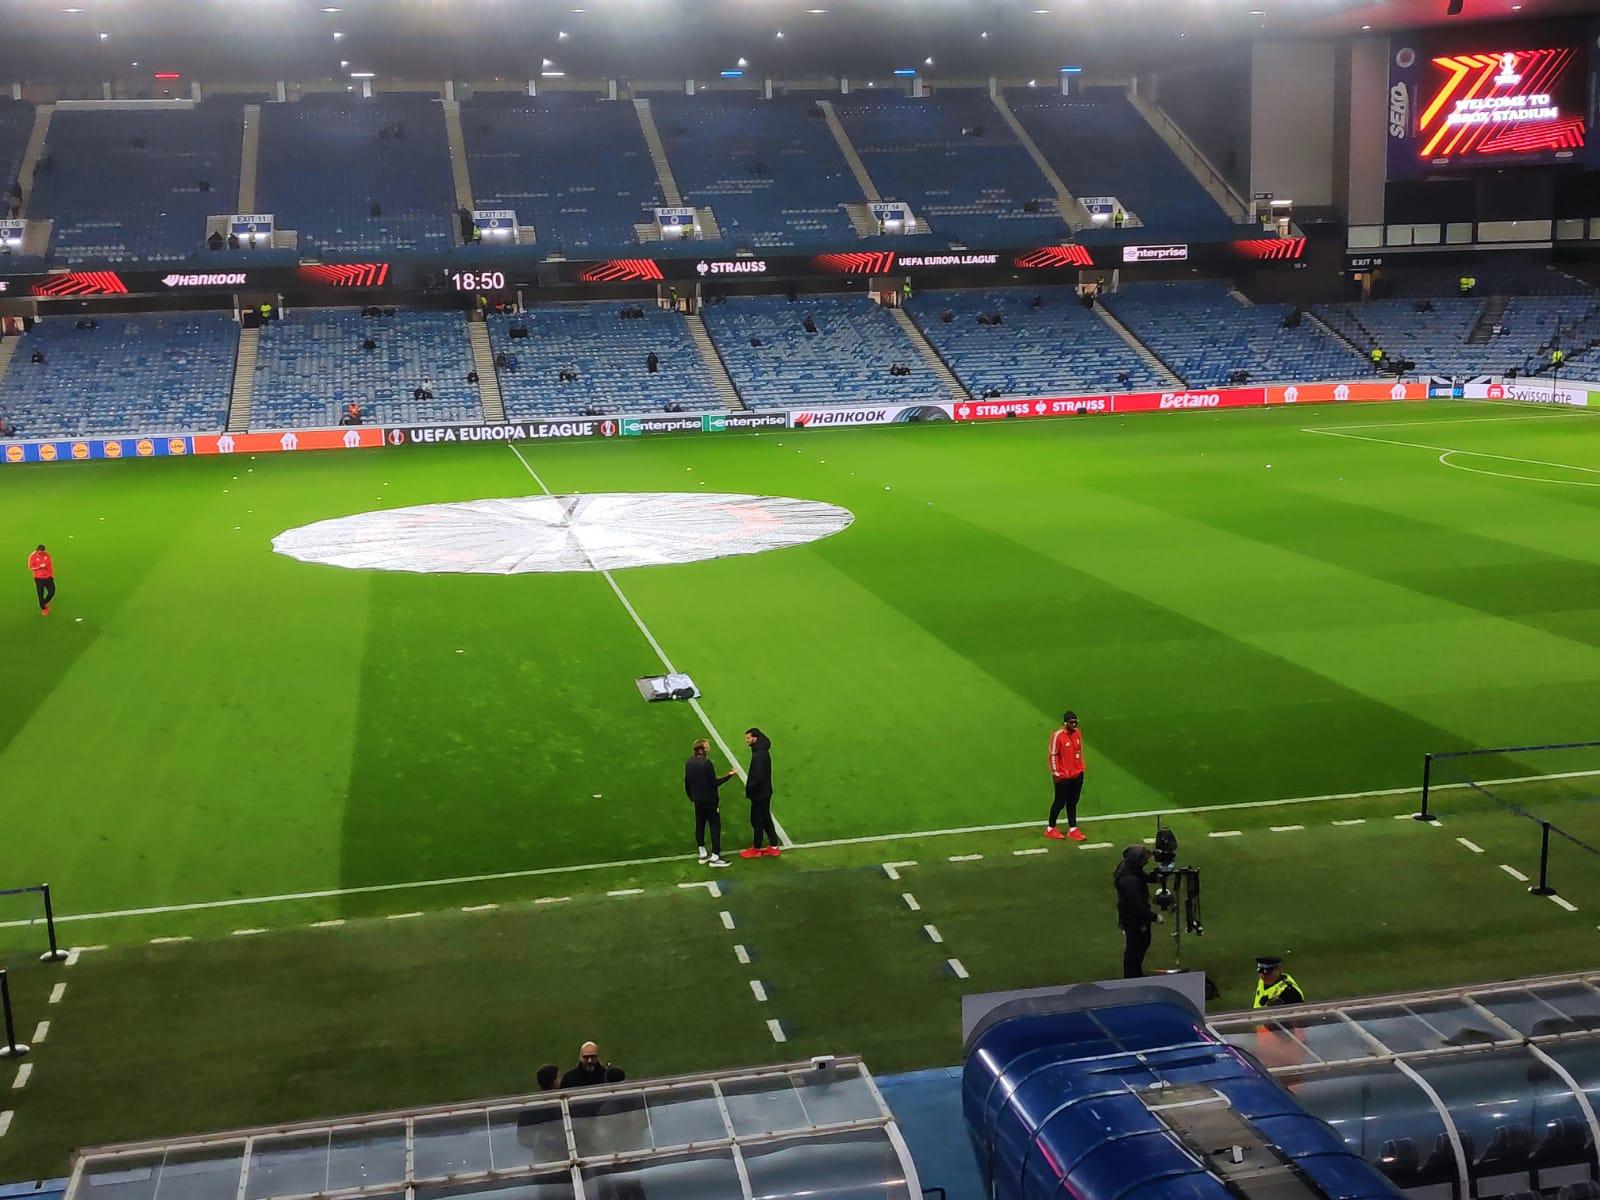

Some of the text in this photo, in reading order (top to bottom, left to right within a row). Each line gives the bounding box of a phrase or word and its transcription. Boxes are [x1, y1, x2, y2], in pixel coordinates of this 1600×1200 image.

[1390, 82, 1409, 139] SEKO
[1456, 94, 1550, 111] WELCOME TO
[1492, 107, 1558, 121] STADIUM
[710, 261, 767, 274] STRAUSS
[899, 255, 996, 267] UEFA EUROPA LEAGUE
[452, 272, 505, 291] 18:50
[976, 399, 1105, 416] STRAUSS STRAUSS
[1159, 393, 1220, 409] Betano
[629, 419, 701, 432] enterprise
[714, 415, 785, 428] enterprise
[410, 421, 594, 443] UEFA EUROPA LEAGUE
